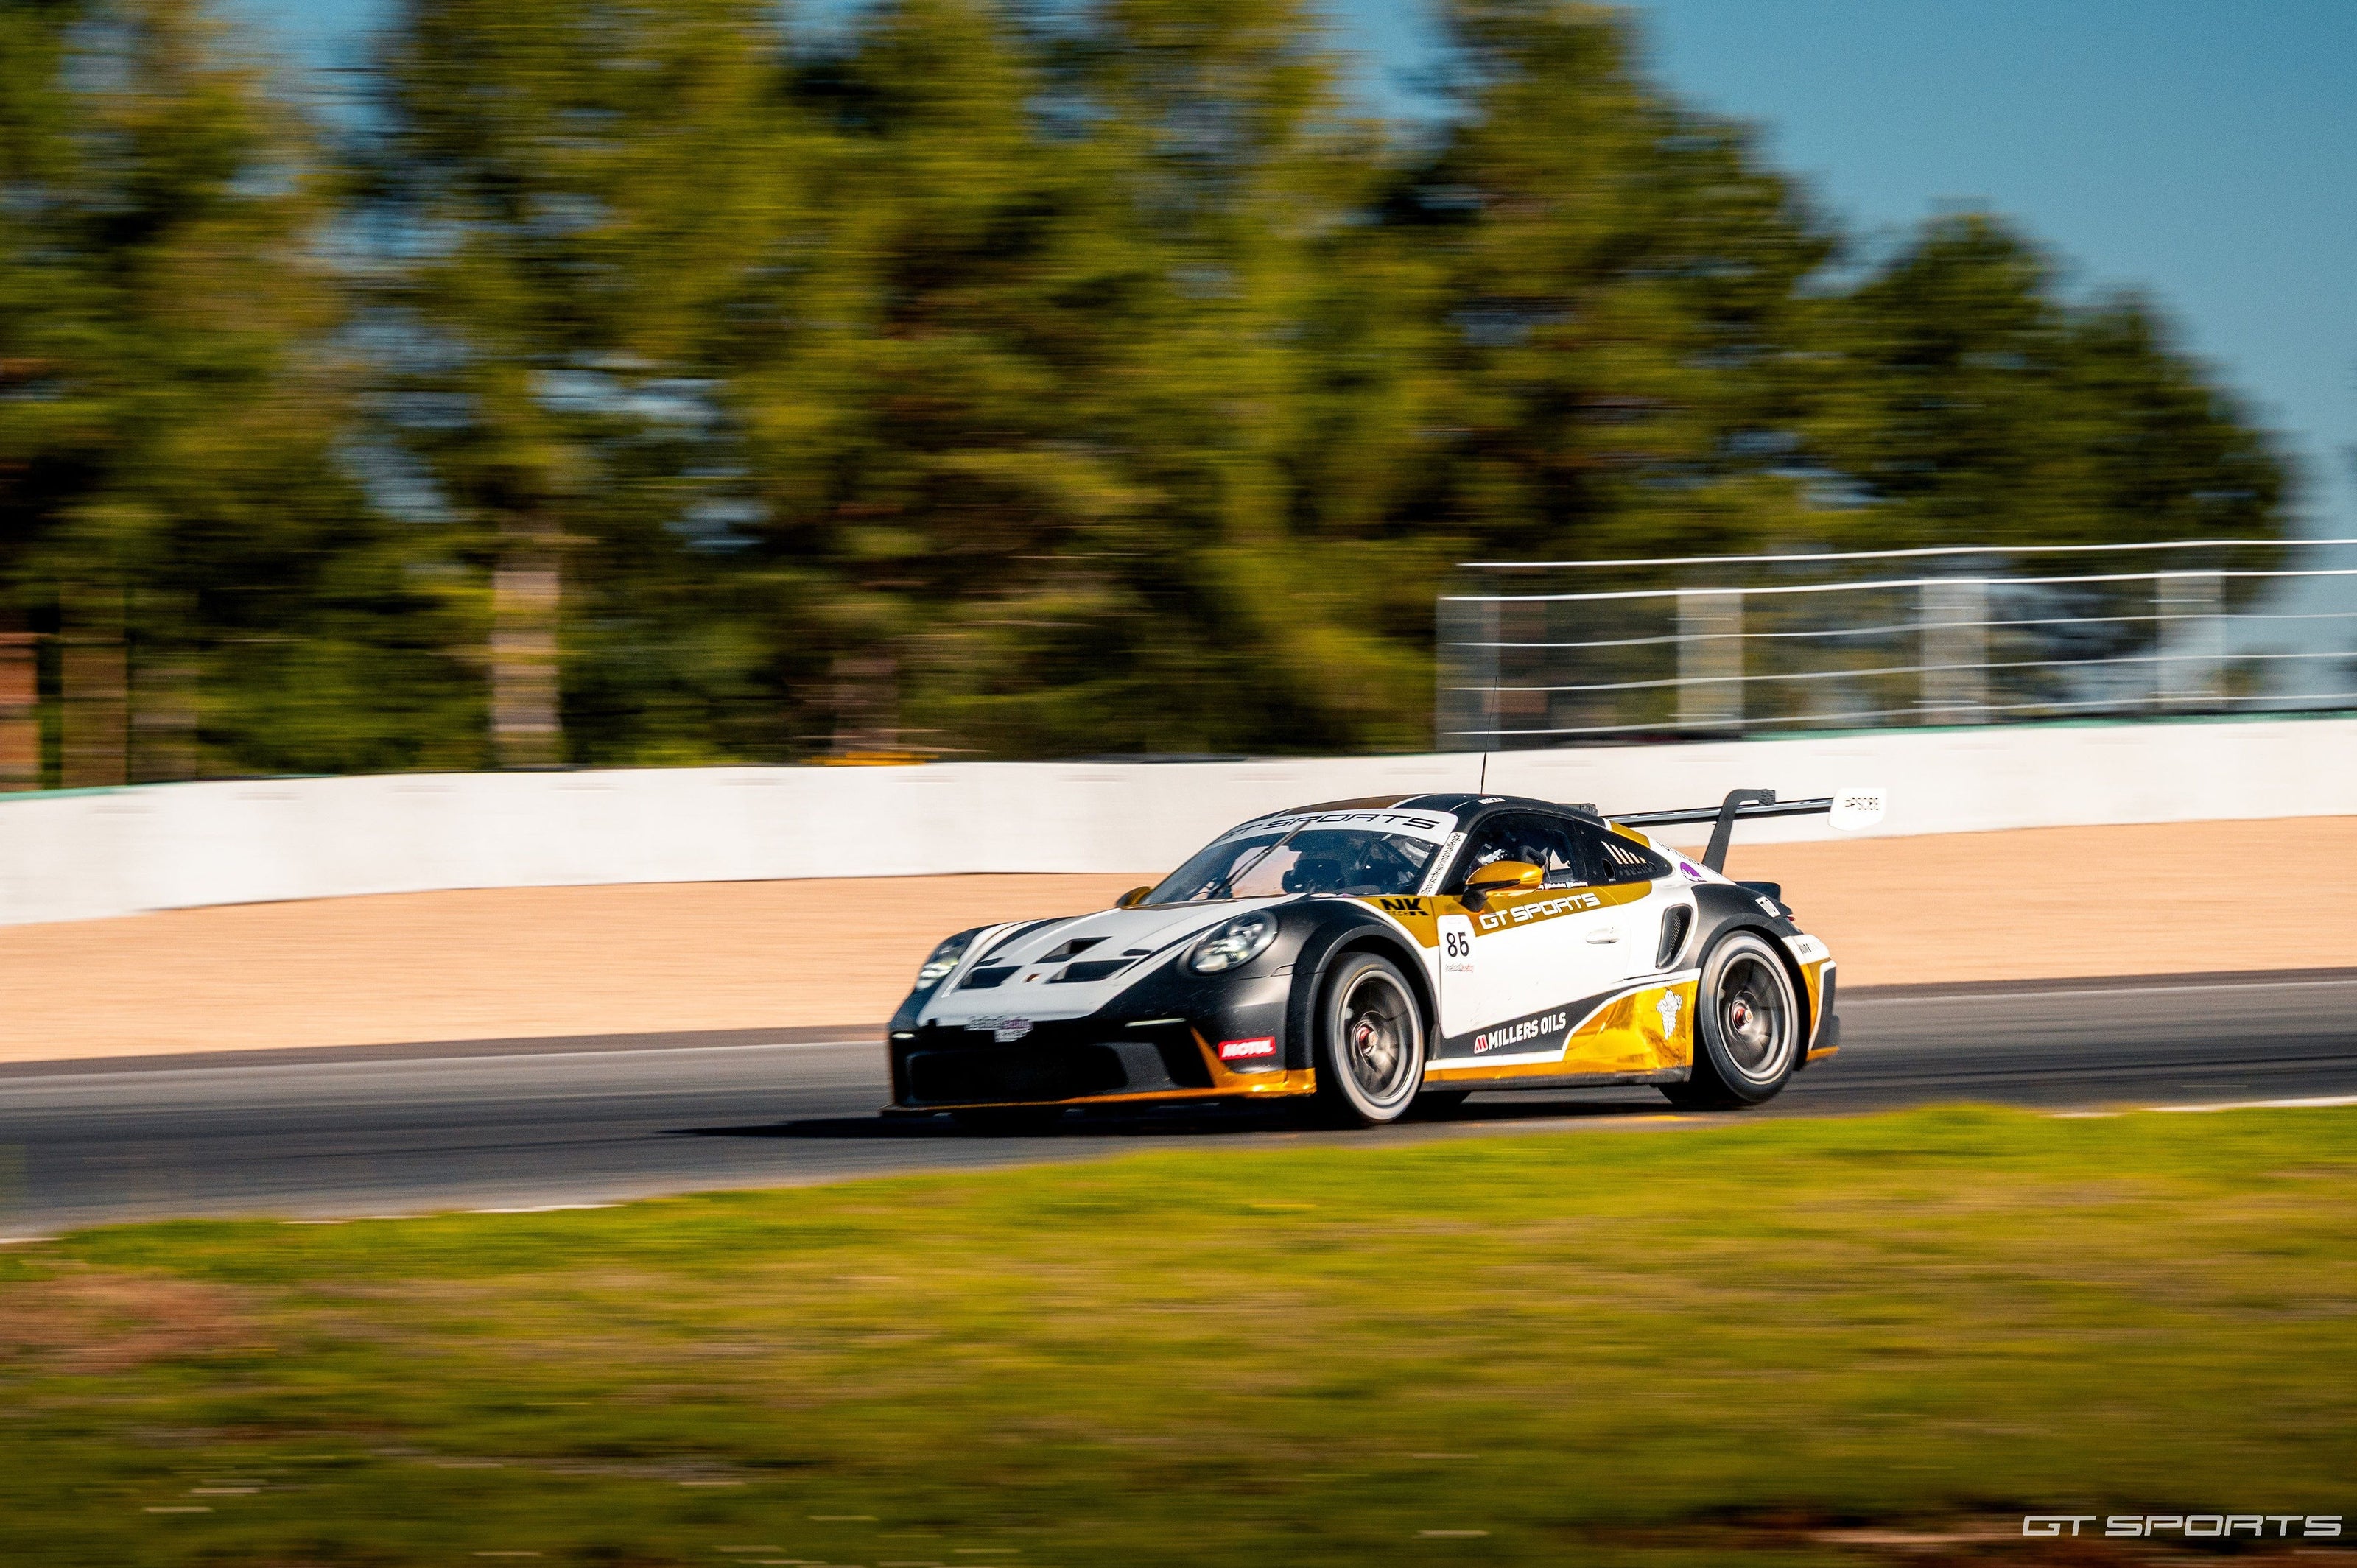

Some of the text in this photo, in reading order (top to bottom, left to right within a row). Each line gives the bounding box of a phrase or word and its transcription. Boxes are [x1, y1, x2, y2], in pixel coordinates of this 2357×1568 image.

[1260, 813, 1439, 830] SPORTS
[1479, 892, 1601, 930] GT SPORTS
[1488, 1011, 1567, 1050] MILLERS OILS
[1221, 1039, 1274, 1058] MOTUL
